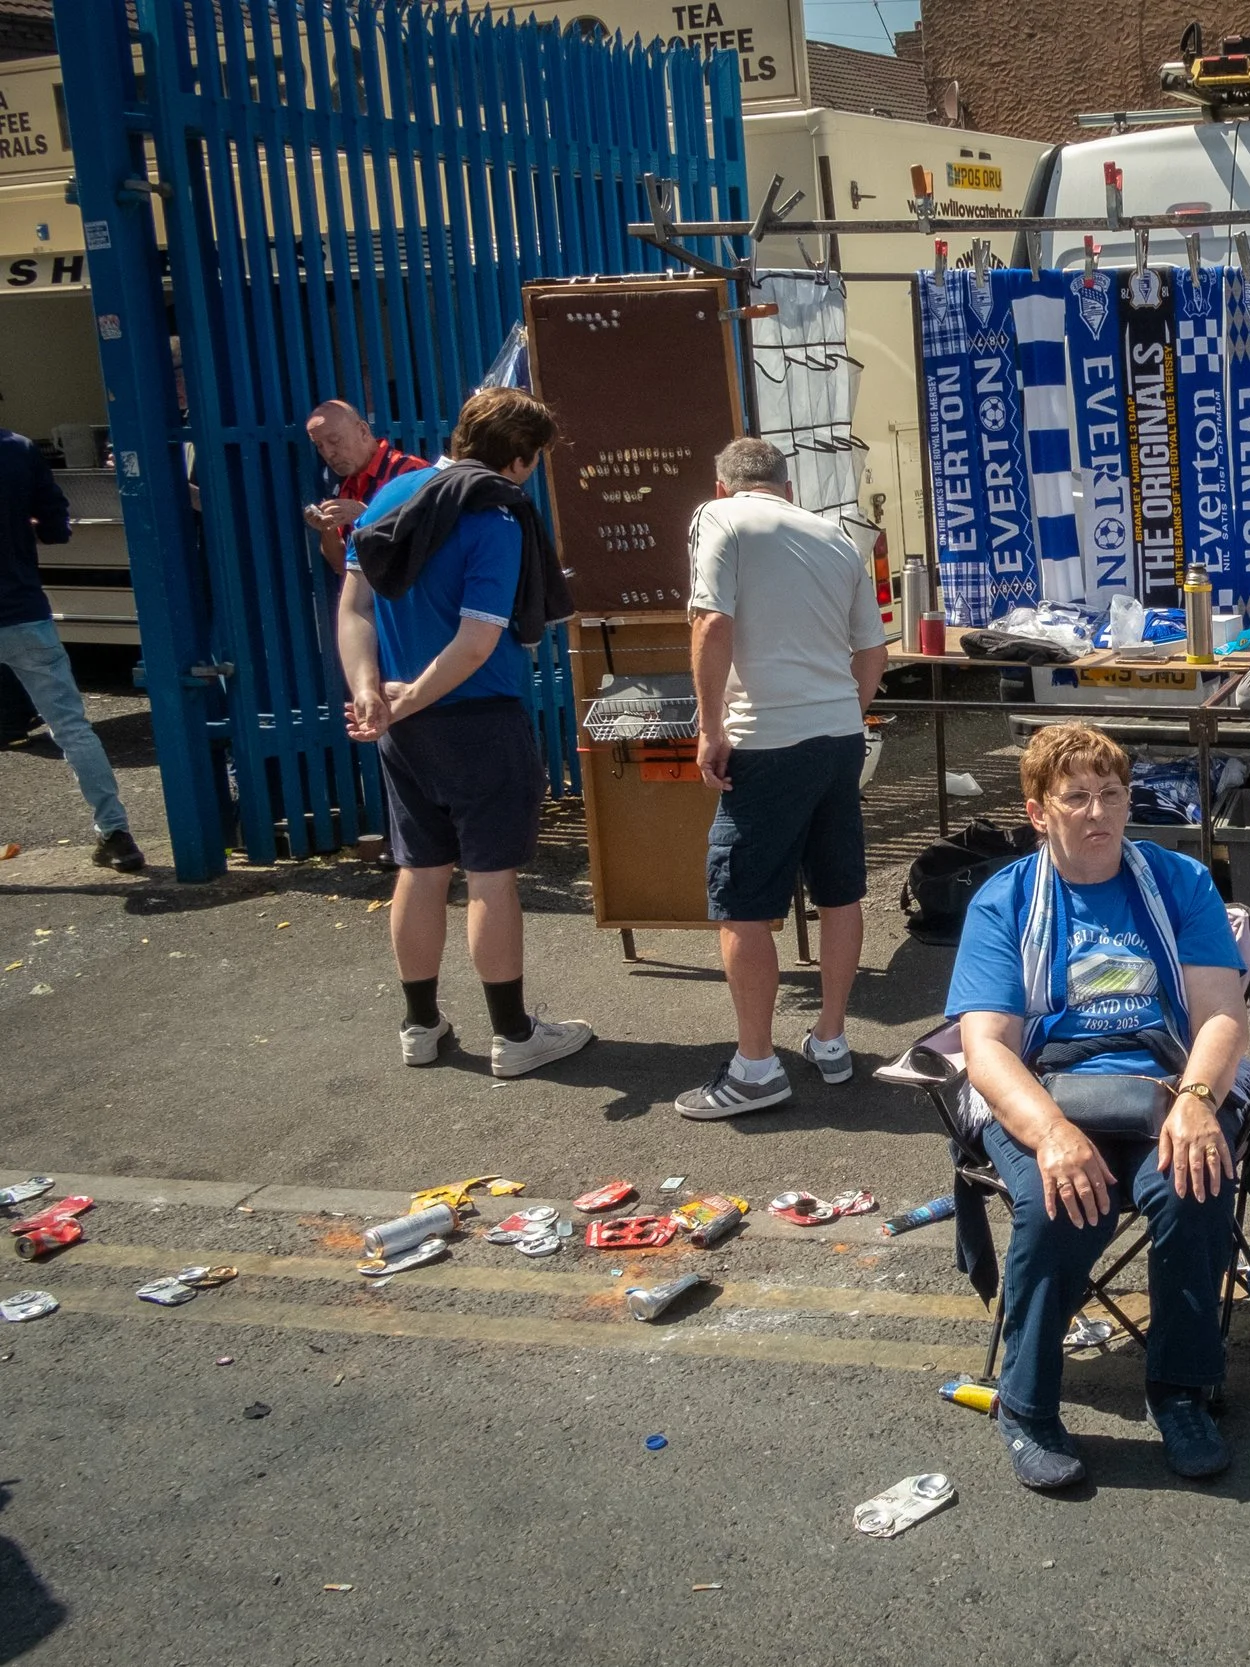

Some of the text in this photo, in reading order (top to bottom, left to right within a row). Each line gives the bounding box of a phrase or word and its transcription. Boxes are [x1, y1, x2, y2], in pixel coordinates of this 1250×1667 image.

[672, 2, 724, 31] TEA
[927, 375, 947, 546] ON THE BANKS OF THE ROYAL BLUE MERSEY
[937, 365, 977, 552] EVERTON
[1130, 443, 1140, 483] MOORE
[1132, 342, 1175, 594] THE ORIGINALS
[1132, 487, 1143, 541] BRAMLEY
[1163, 345, 1184, 586] ON THE BANKS OF THE ROYAL BLUE MERSEY
[1191, 388, 1223, 573] Everton
[1214, 391, 1230, 571] NIL SATIS NISI OPTIMUM
[1099, 935, 1110, 945] to
[1116, 1015, 1140, 1030] 2025
